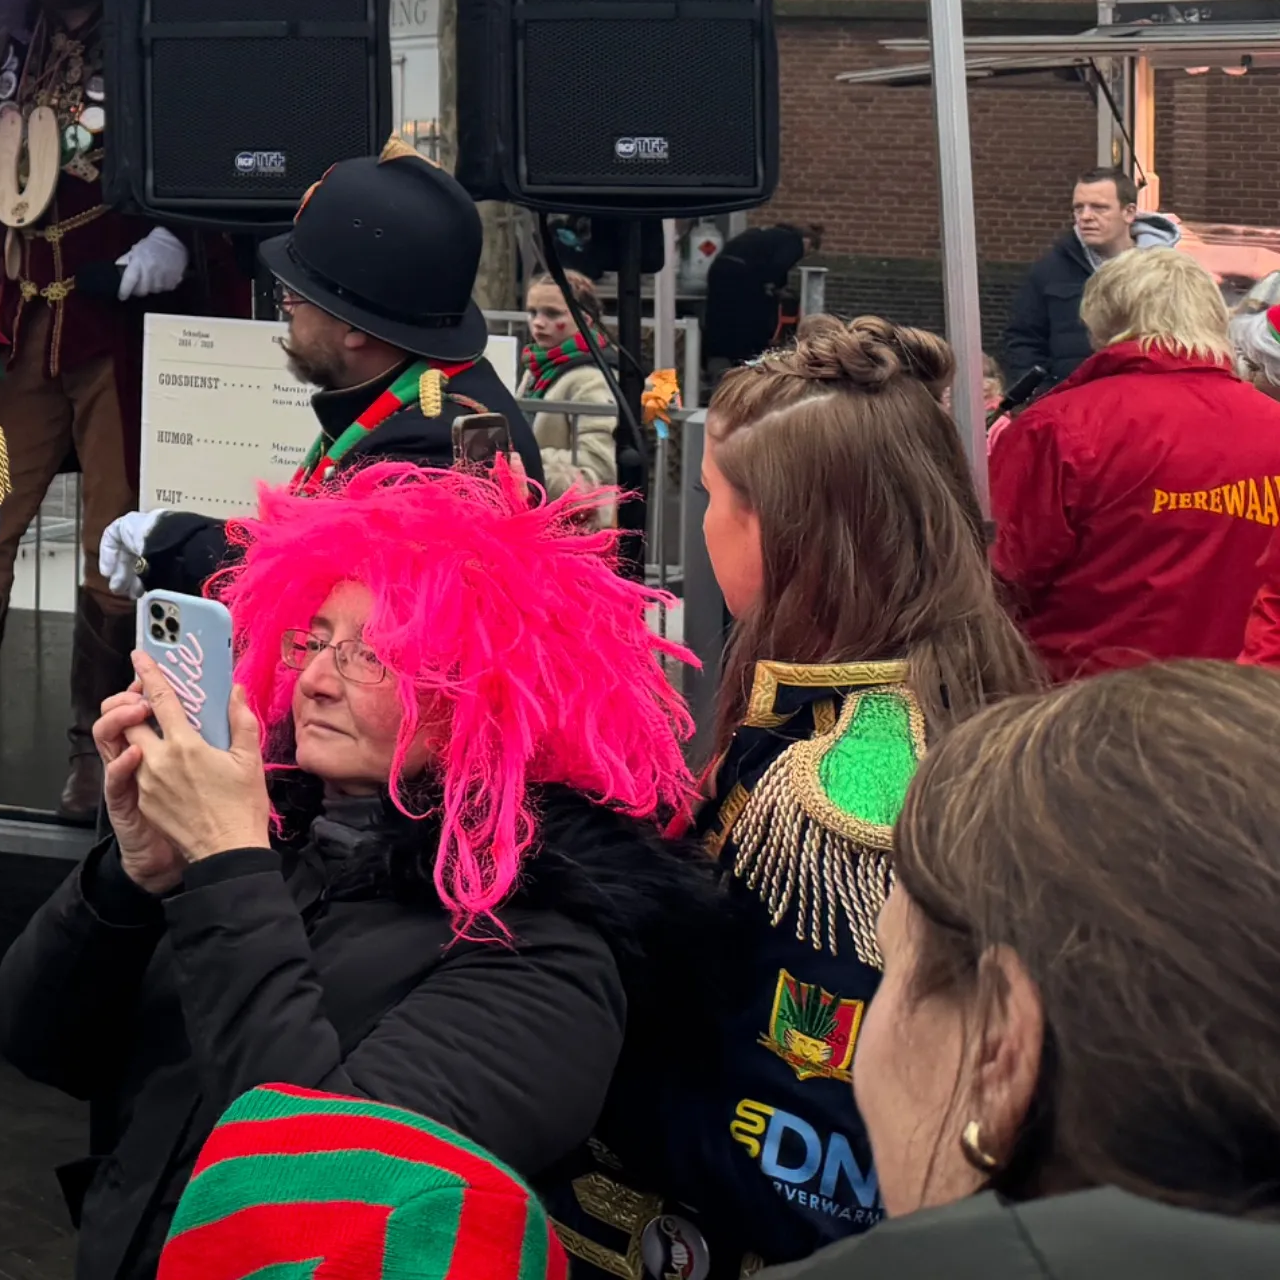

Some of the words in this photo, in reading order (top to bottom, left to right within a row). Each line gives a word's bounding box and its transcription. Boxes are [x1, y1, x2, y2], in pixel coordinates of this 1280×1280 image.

[158, 373, 221, 390] GODSDIENST
[157, 430, 194, 446] HUMOR
[156, 489, 183, 505] VLIJT
[760, 1106, 886, 1211] DN
